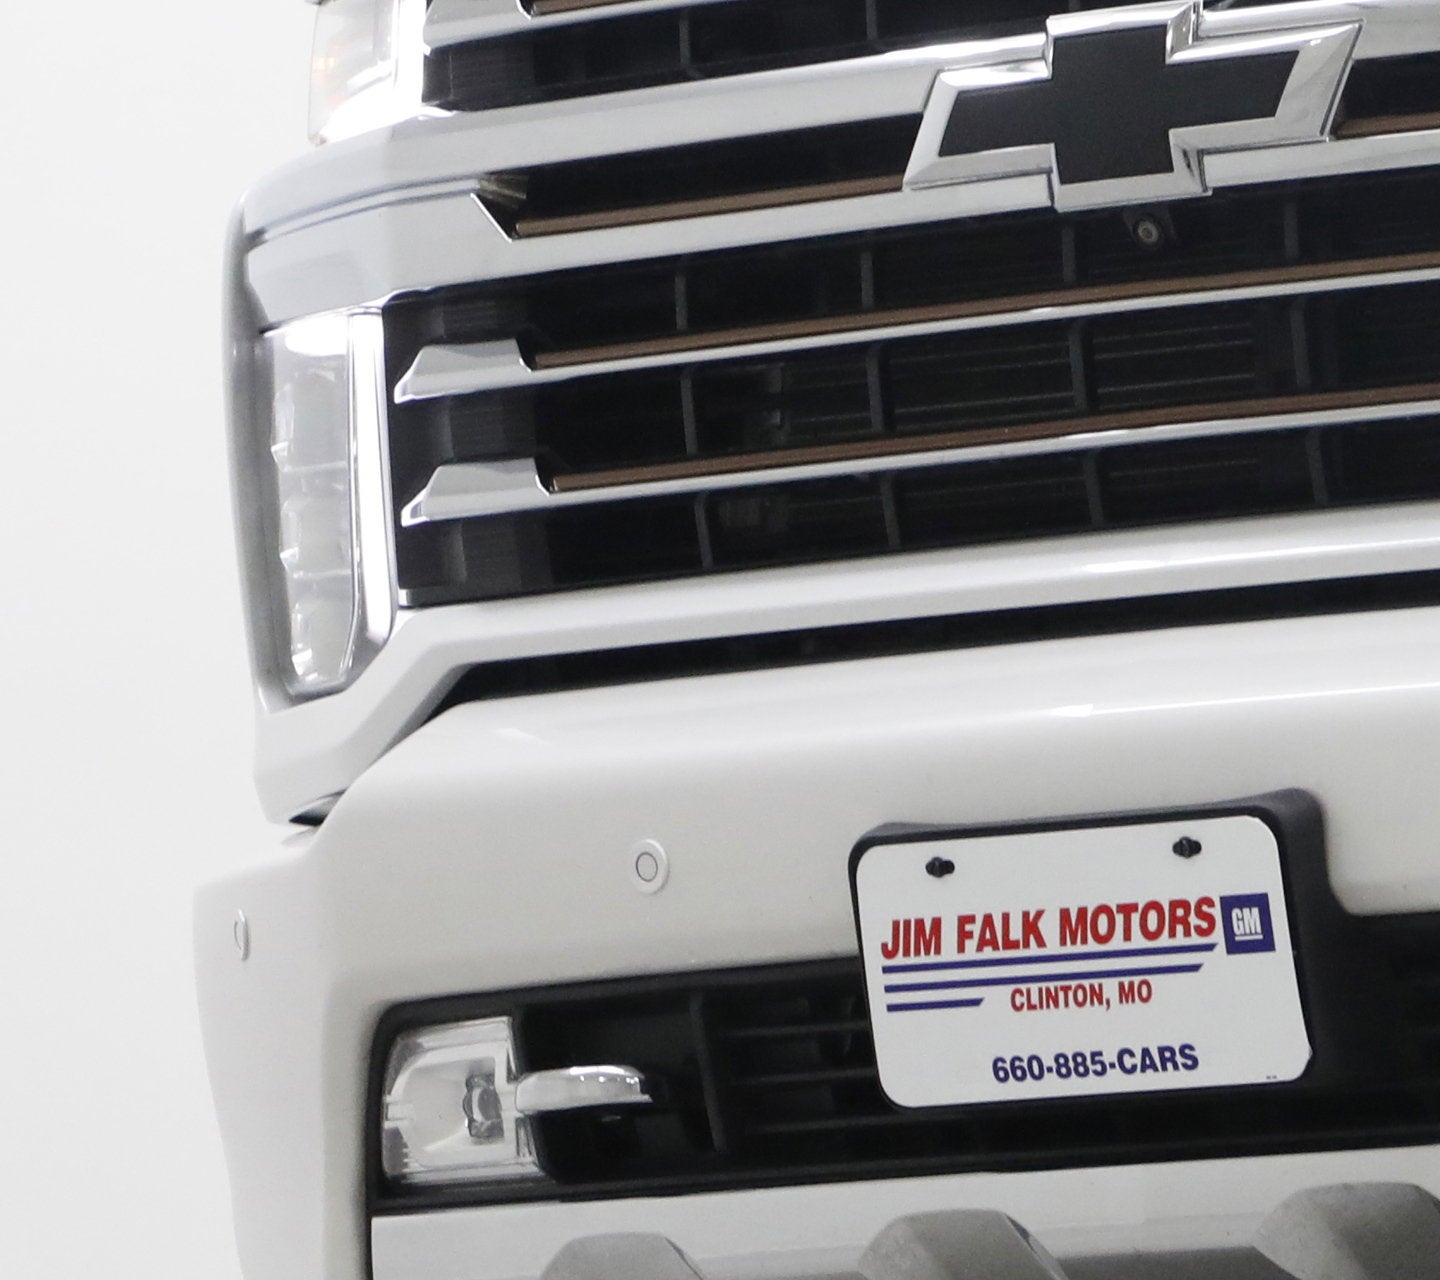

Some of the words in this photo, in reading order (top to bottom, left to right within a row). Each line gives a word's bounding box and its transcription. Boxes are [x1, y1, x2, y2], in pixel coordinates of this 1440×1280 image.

[881, 917, 942, 960] JIM
[956, 909, 1047, 954] FALK
[1059, 896, 1217, 947] MOTORS
[1231, 907, 1262, 936] GM
[1010, 982, 1111, 1012] CLINTON,
[1118, 979, 1153, 1004] MO
[992, 1044, 1200, 1083] 660-885-CARS
